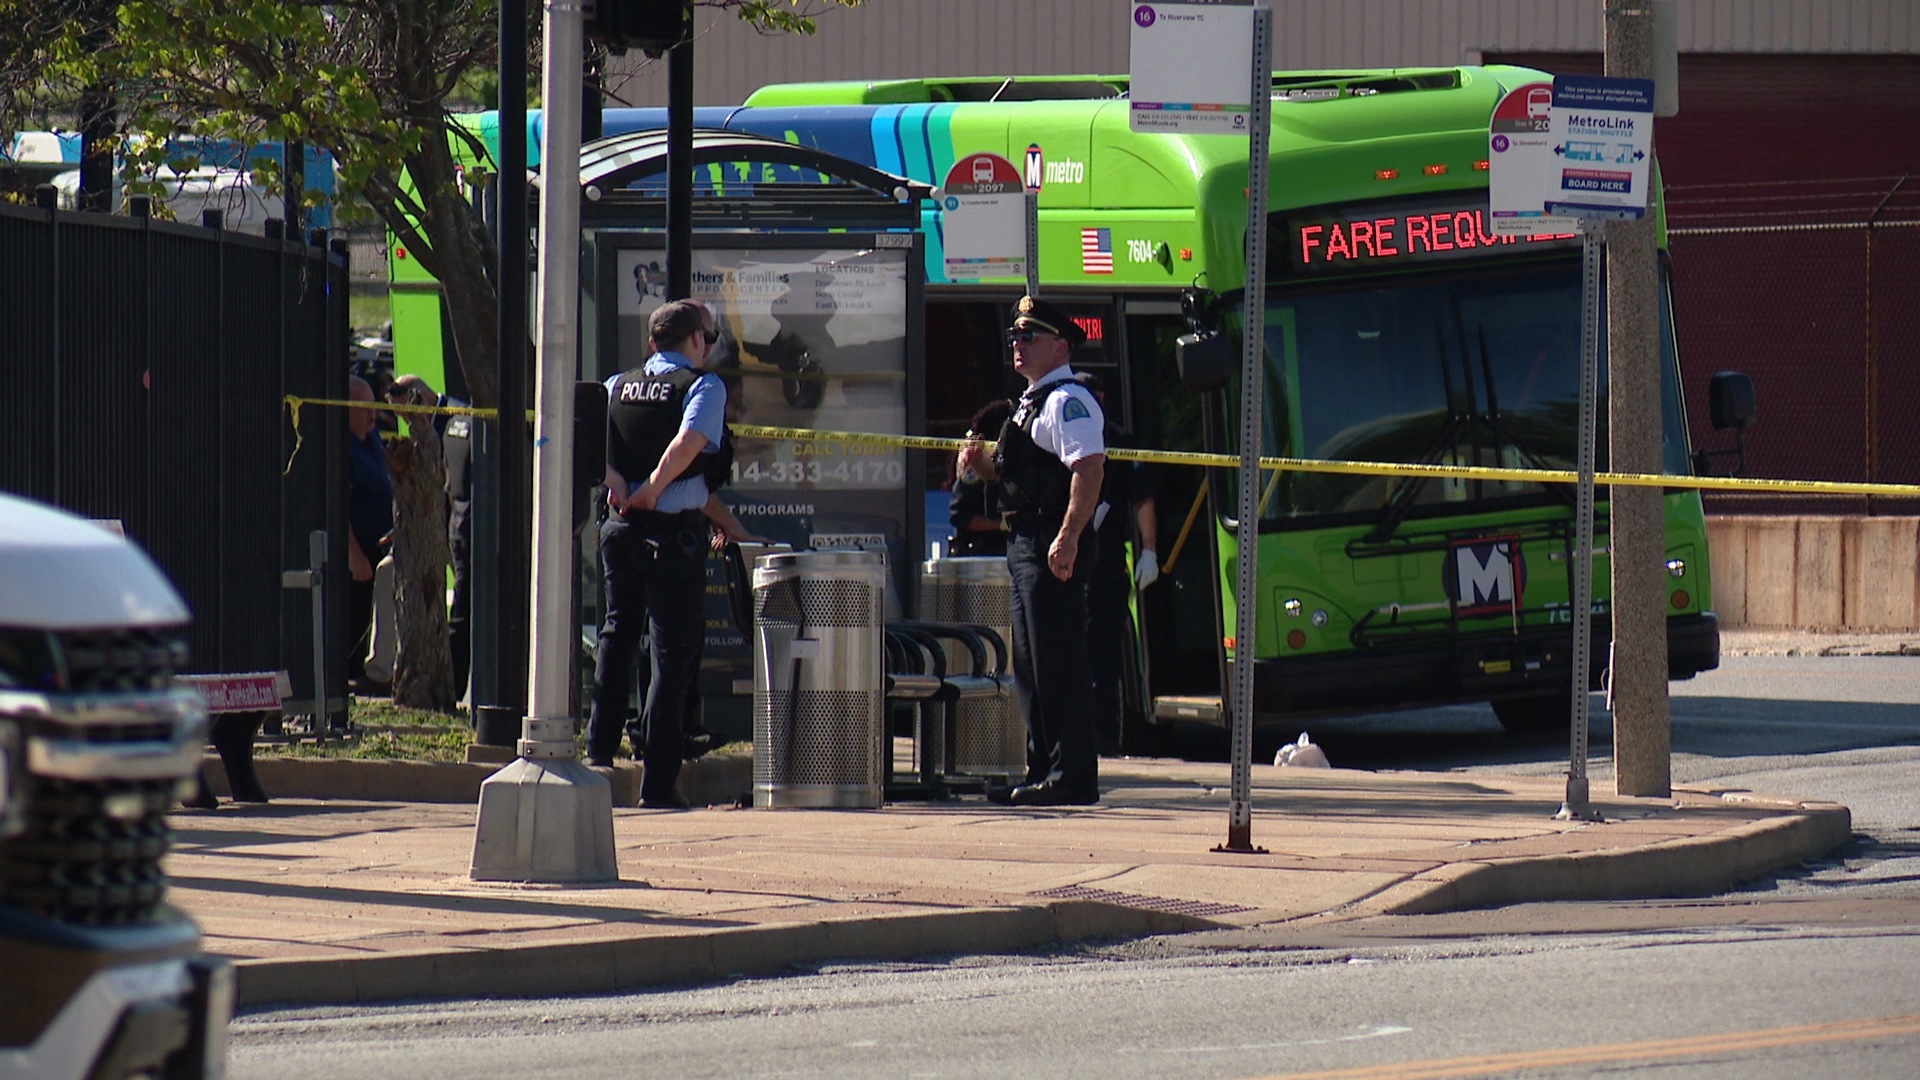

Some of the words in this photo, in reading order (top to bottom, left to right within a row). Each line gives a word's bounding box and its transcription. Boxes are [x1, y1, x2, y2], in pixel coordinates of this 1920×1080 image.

[1140, 11, 1151, 21] 16
[1568, 115, 1634, 130] MetroLink
[1600, 129, 1633, 137] SHUTTLE
[1496, 139, 1506, 148] 16
[1046, 157, 1084, 183] metro
[979, 183, 1005, 193] 2097
[1568, 179, 1599, 189] BOARD
[1600, 182, 1625, 191] HERE
[877, 235, 911, 247] 37999
[1301, 218, 1398, 263] FARE
[1127, 239, 1152, 263] 7604
[815, 265, 875, 274] LOCATIONS
[726, 271, 736, 284] &
[738, 271, 789, 284] Families
[738, 285, 788, 295] CENTER
[815, 301, 832, 309] East
[620, 382, 671, 401] POLICE
[792, 444, 834, 456] CALL
[841, 444, 897, 456] TODAY
[731, 460, 903, 483] 14-333-4170
[739, 504, 815, 515] PROGRAMS
